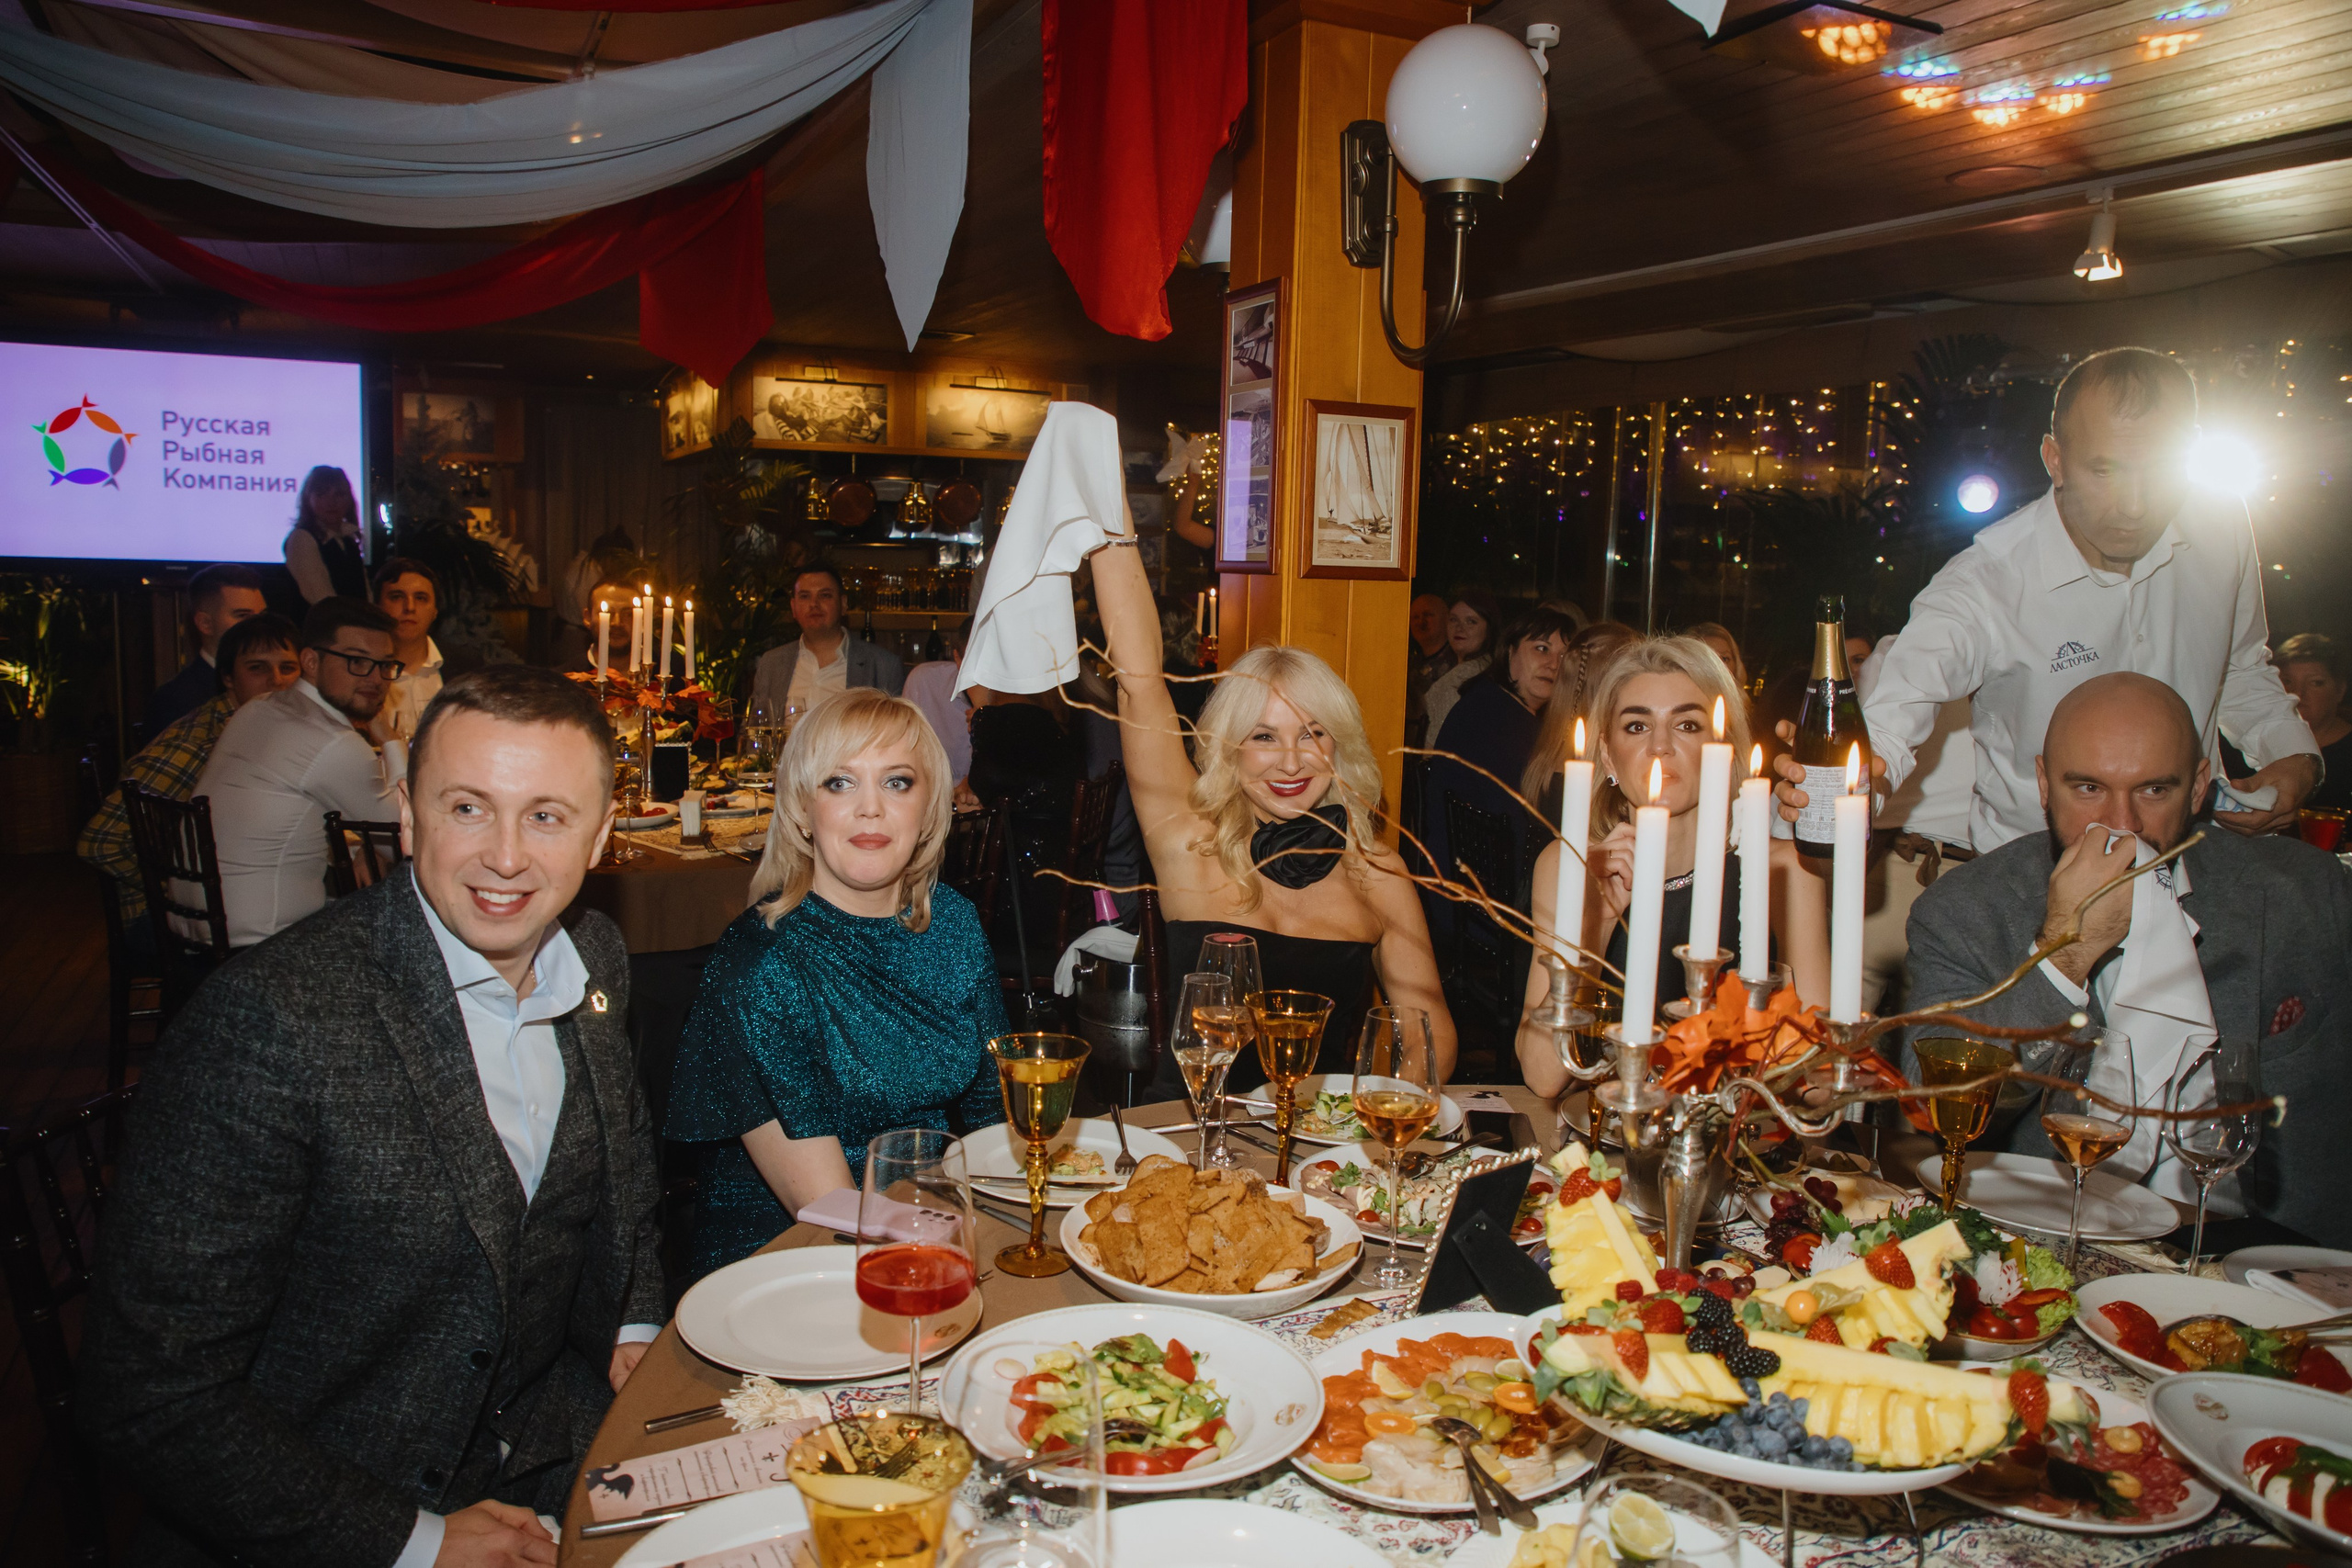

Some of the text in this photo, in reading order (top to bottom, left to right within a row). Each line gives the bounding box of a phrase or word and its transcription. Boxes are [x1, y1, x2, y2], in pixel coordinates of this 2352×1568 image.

[162, 411, 270, 437] Русская
[162, 440, 266, 465] Рыбная
[163, 467, 298, 493] Компания
[2050, 651, 2100, 673] ЛАСТОЧКА
